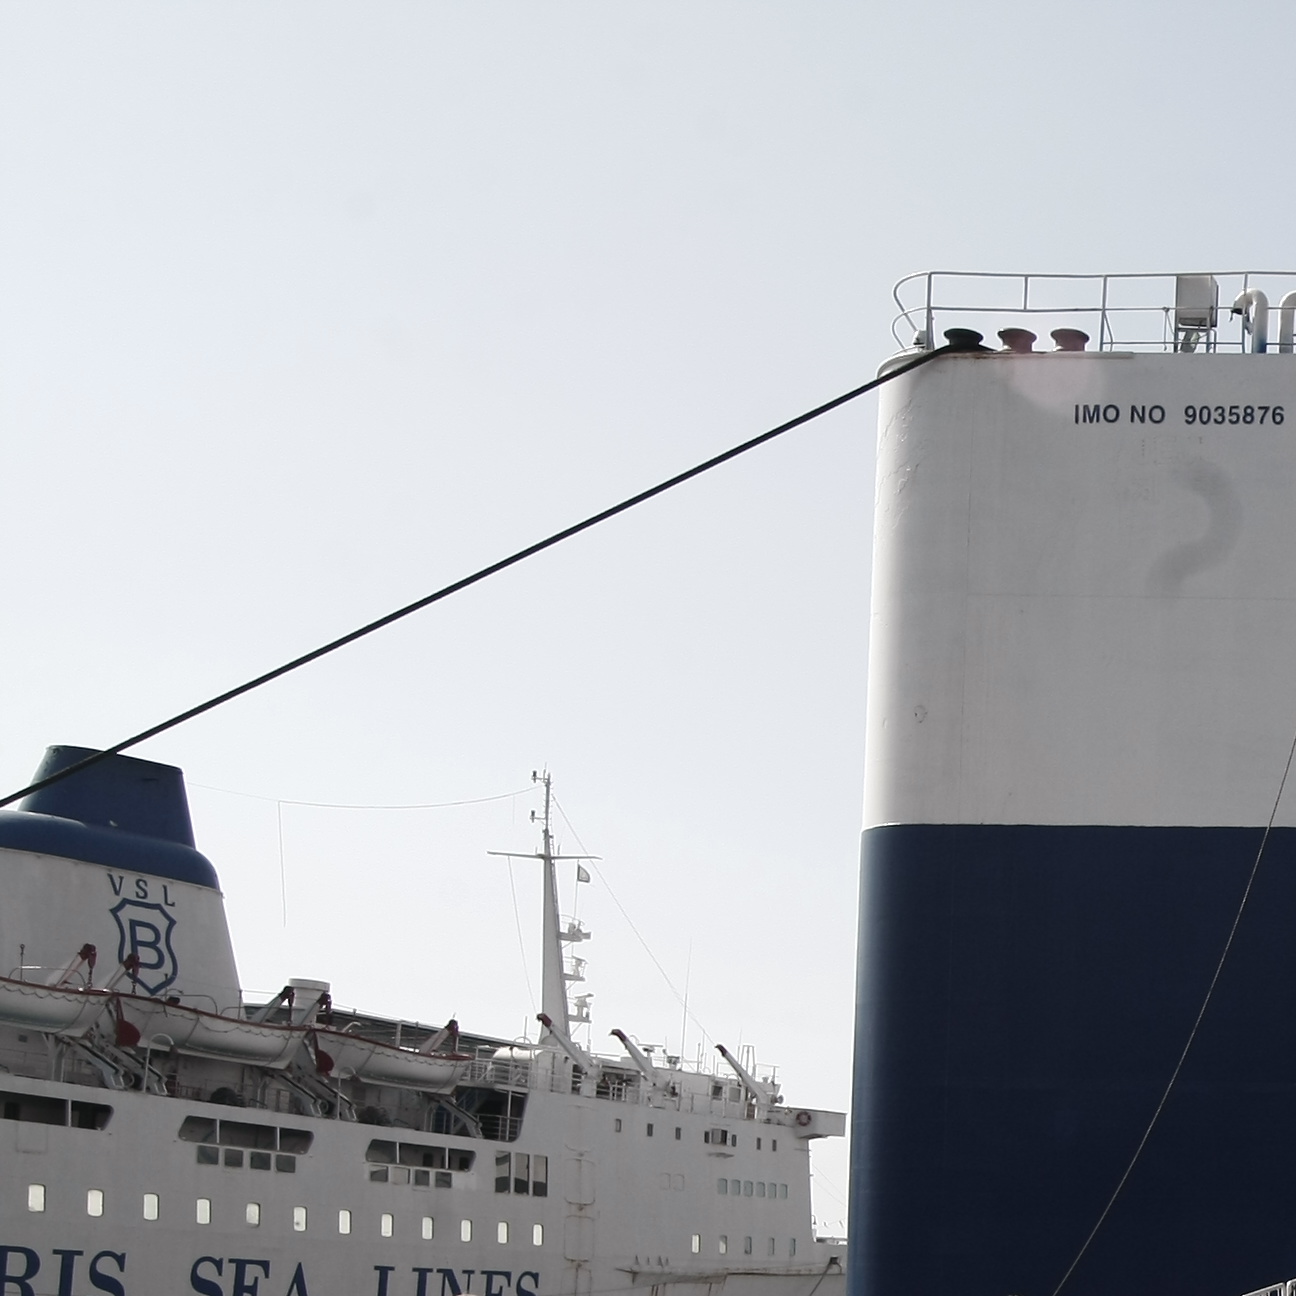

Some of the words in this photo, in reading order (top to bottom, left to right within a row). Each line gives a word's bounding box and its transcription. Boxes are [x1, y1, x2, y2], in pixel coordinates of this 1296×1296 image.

[1074, 404, 1120, 425] IMO
[1130, 405, 1166, 424] NO
[1184, 405, 1285, 425] 9035876
[128, 918, 165, 970] B
